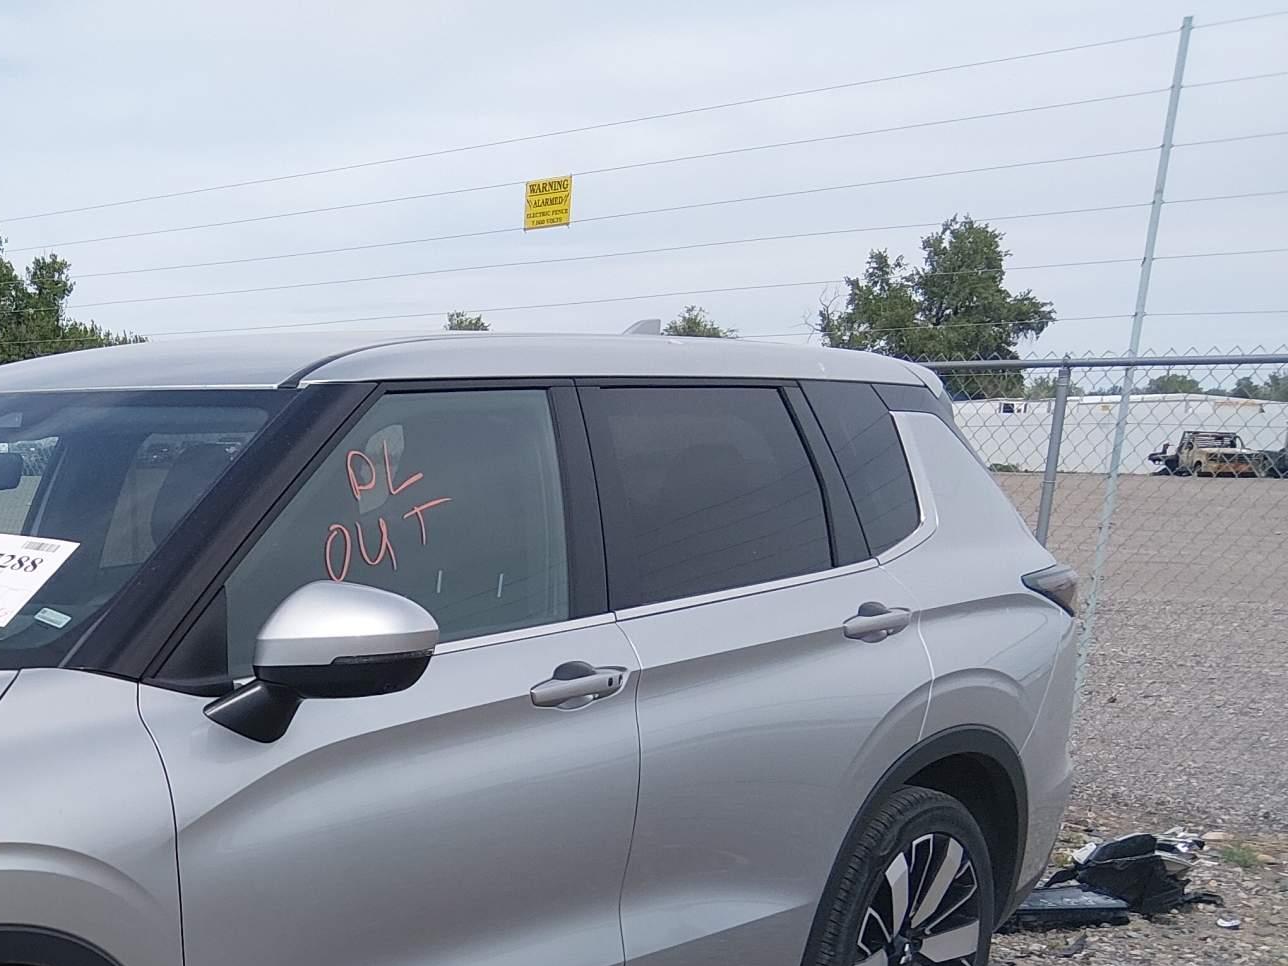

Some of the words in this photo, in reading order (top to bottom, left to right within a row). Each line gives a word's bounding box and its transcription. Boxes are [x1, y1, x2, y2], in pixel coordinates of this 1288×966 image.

[529, 179, 569, 194] WARNING
[532, 196, 564, 208] ALARMED
[325, 496, 453, 582] OUT
